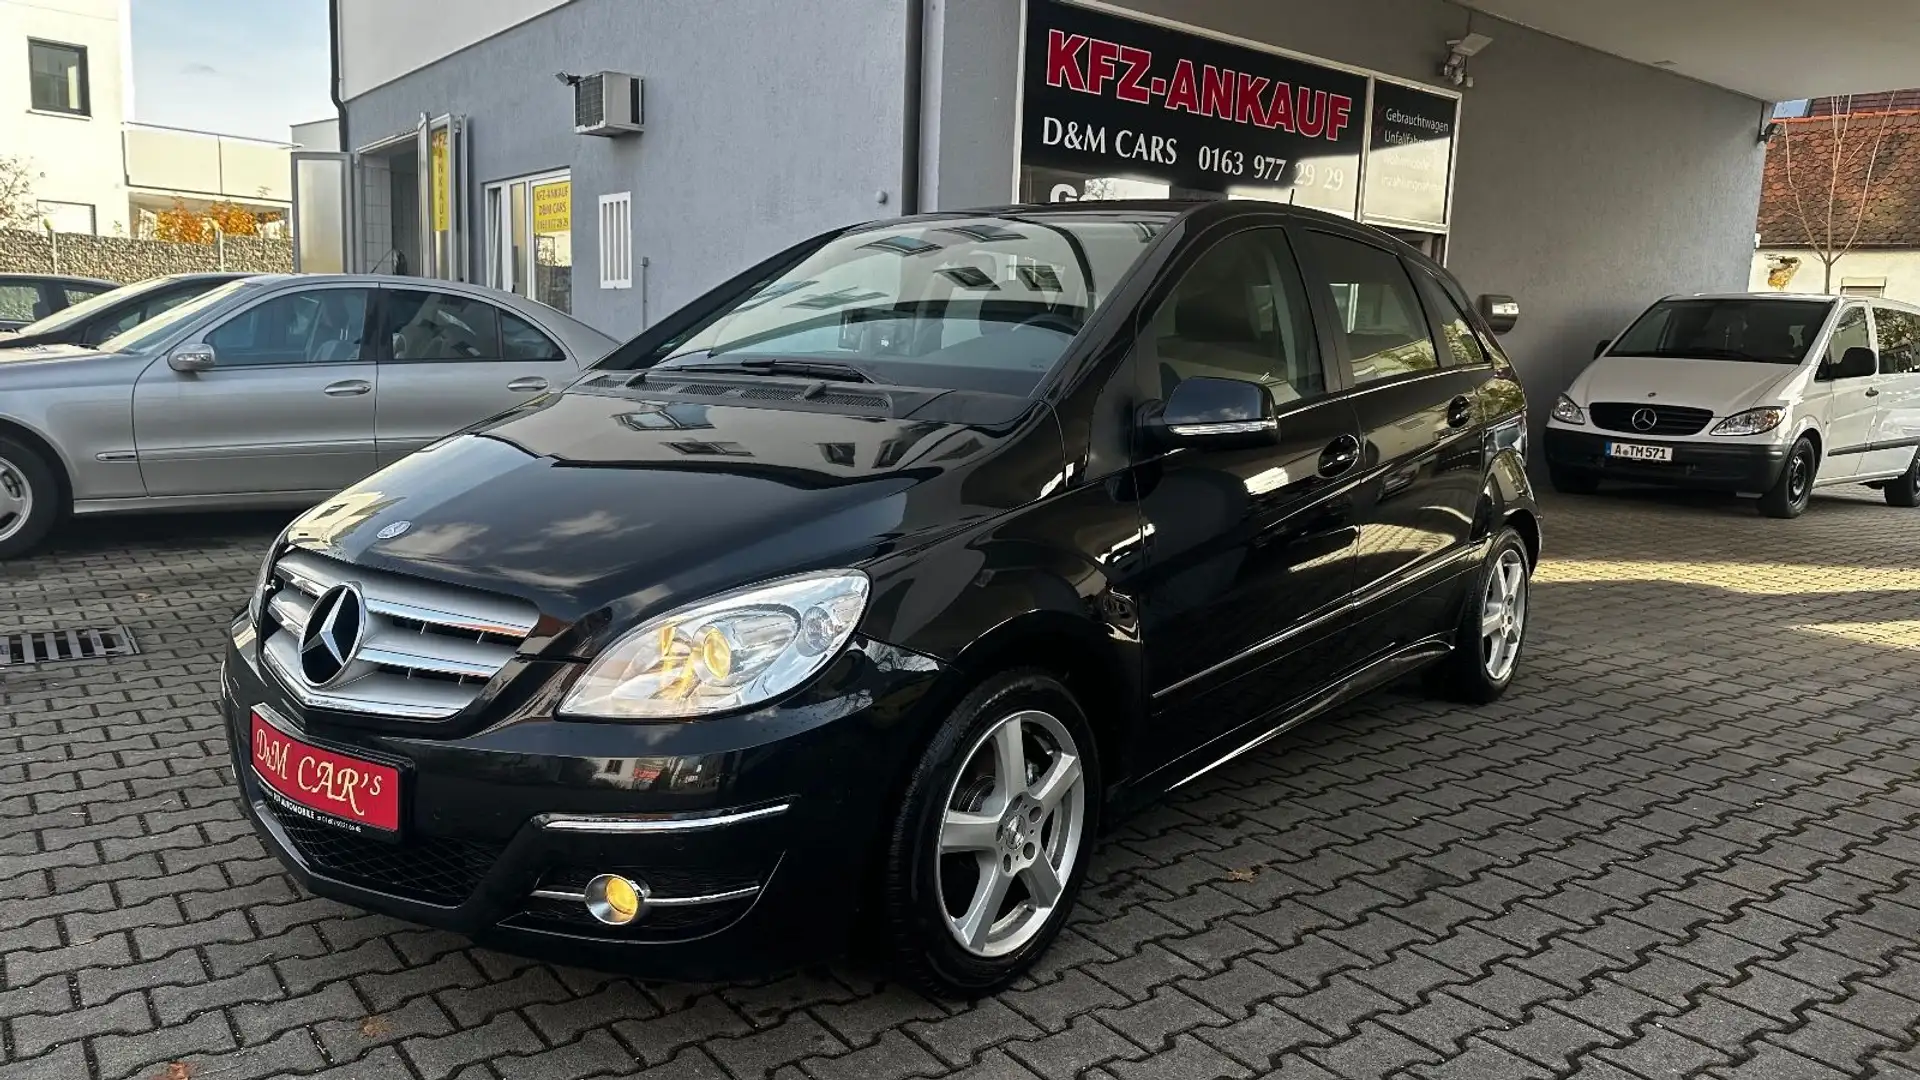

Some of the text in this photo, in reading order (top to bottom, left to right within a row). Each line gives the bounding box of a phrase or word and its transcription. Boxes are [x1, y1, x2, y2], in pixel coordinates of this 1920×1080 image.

[1046, 29, 1353, 142] KFZ-ANKAUF
[1042, 116, 1178, 165] D&M CARS
[1385, 107, 1449, 133] Gebrauchtwagen
[1198, 145, 1345, 191] 0163 977 29 29
